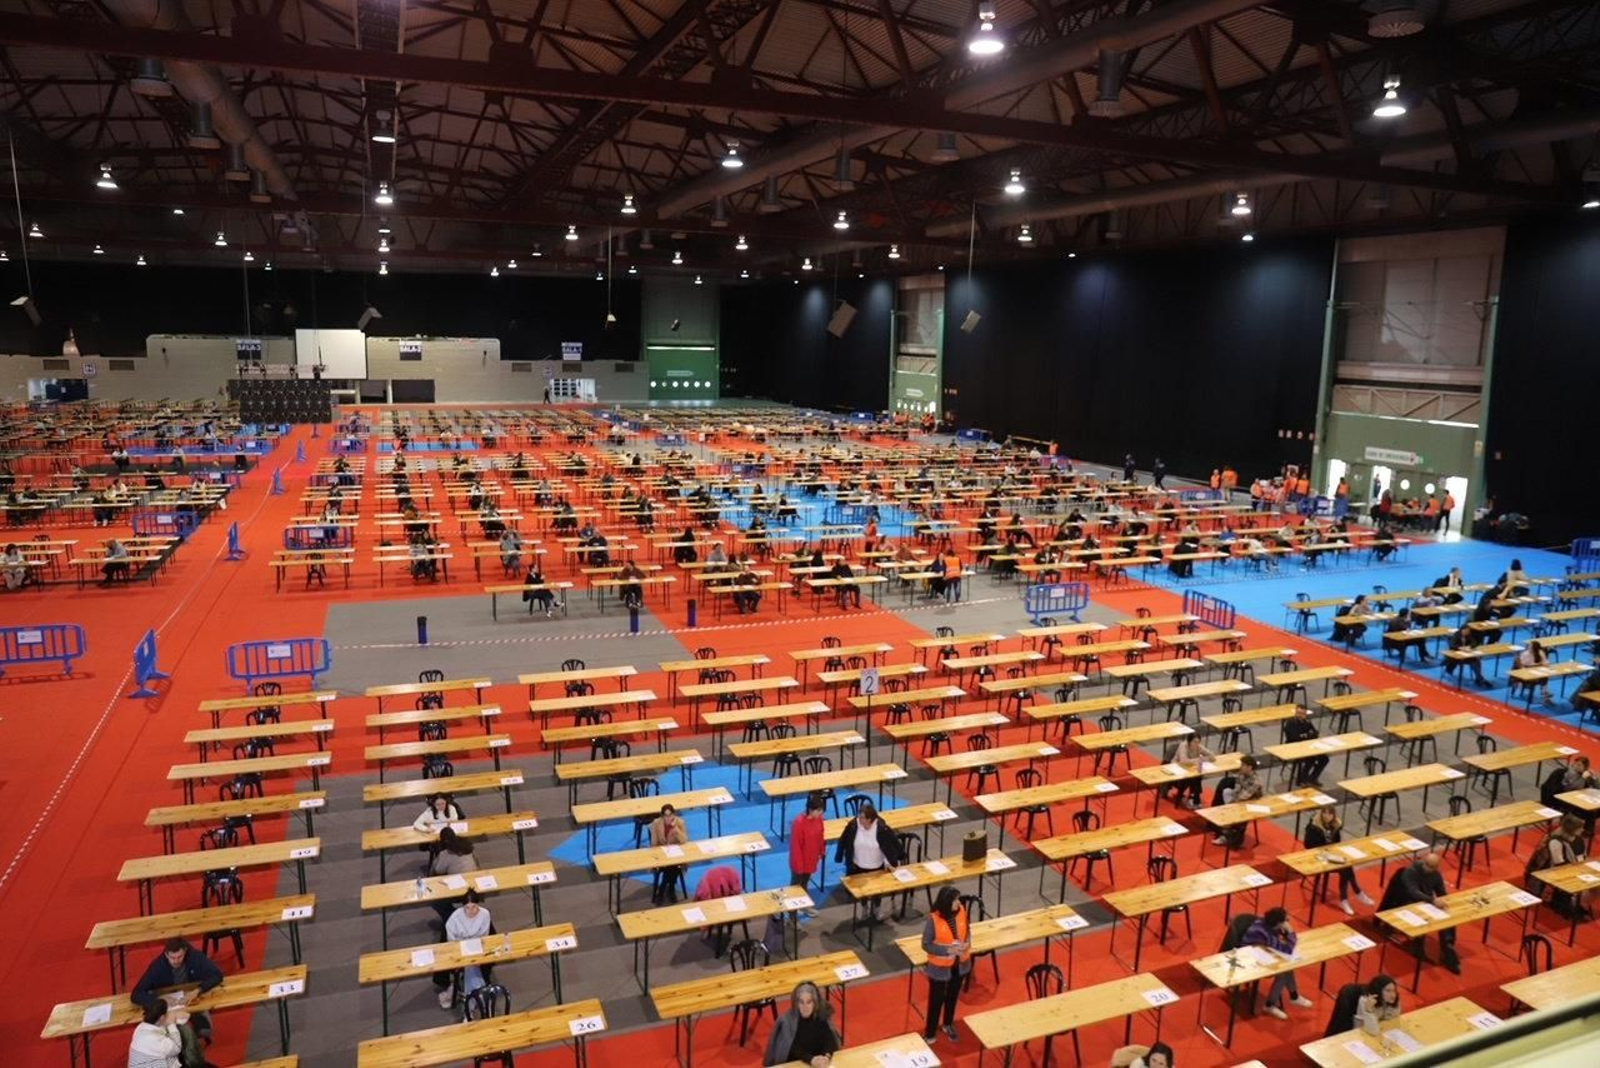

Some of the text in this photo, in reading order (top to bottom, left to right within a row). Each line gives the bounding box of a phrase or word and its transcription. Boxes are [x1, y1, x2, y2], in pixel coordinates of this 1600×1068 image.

[865, 675, 873, 693] 2
[1151, 992, 1169, 1003] 20
[578, 1020, 597, 1031] 26
[910, 1053, 929, 1067] 19
